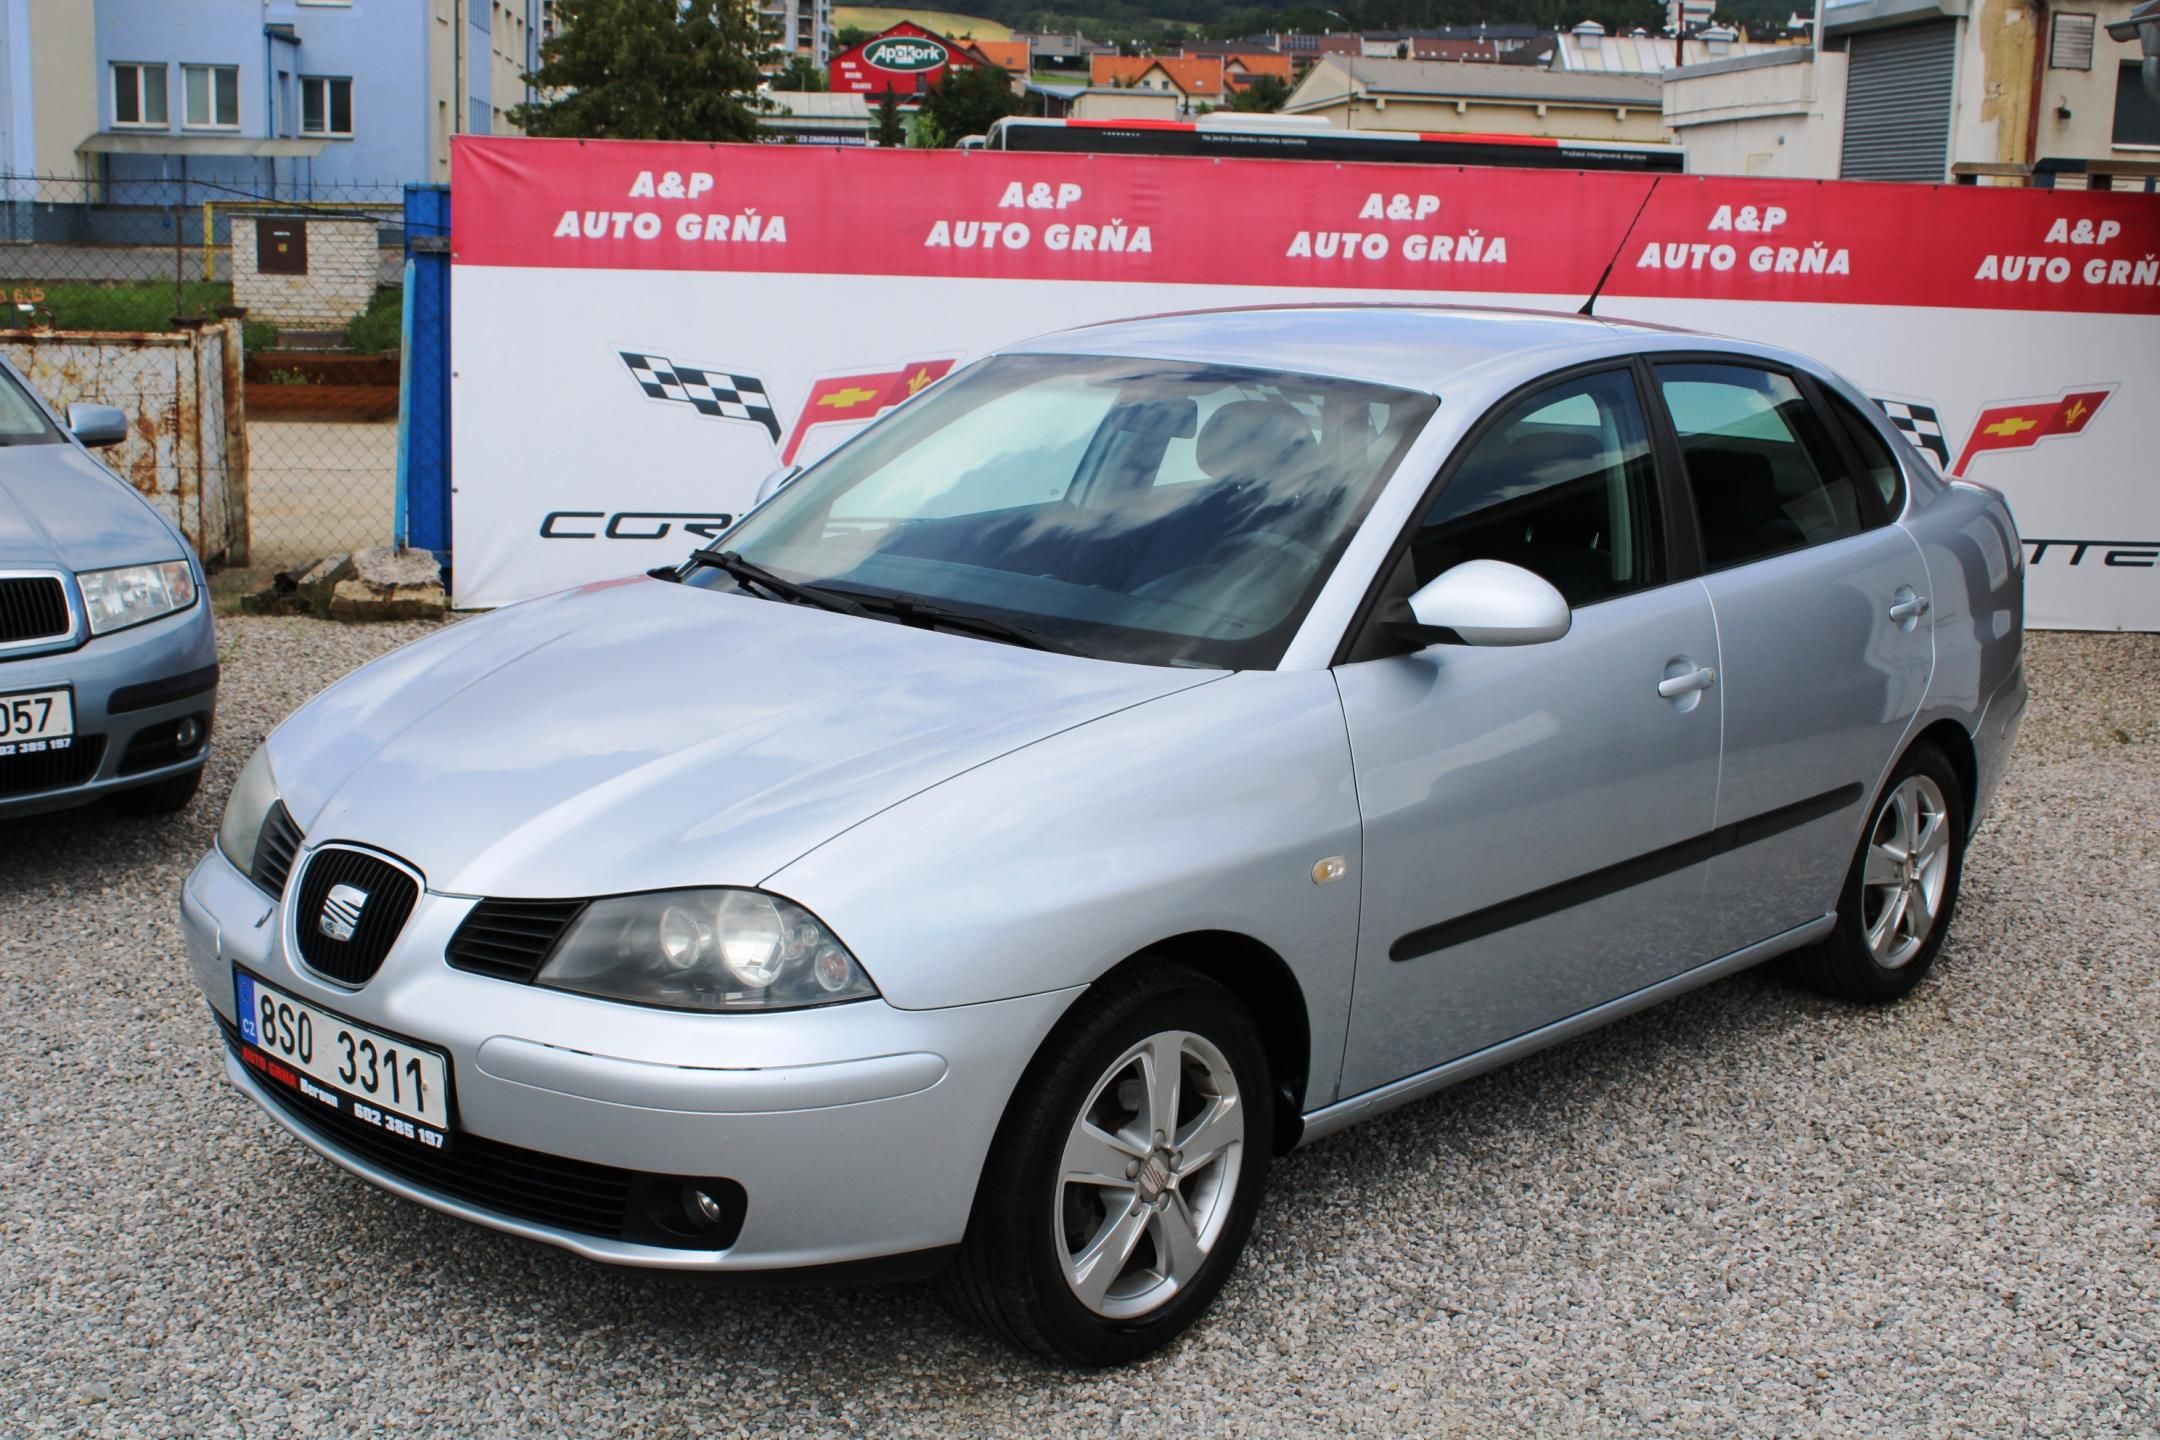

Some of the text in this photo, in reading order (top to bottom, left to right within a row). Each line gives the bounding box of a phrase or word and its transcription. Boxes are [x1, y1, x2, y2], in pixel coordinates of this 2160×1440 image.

[628, 171, 714, 199] A&P
[998, 182, 1082, 210] A&P
[1359, 193, 1441, 221] A&P
[1708, 205, 1787, 233] A&P
[554, 208, 787, 243] AUTO GRŇA
[925, 218, 1152, 253] AUTO GRŇA
[2044, 218, 2121, 245] A&P
[1286, 229, 1507, 264] AUTO GRŇA
[1637, 241, 1850, 275] AUTO GRŇA
[1974, 253, 2160, 285] AUTO GRŇ
[539, 511, 744, 539] COR
[2021, 538, 2160, 567] TTE
[0, 744, 16, 756] 02
[50, 738, 71, 749] 197
[242, 1018, 256, 1037] CZ
[260, 994, 425, 1113] 8S0 3311
[353, 1102, 382, 1127] 602
[384, 1114, 415, 1139] 385
[417, 1128, 444, 1149] 197
